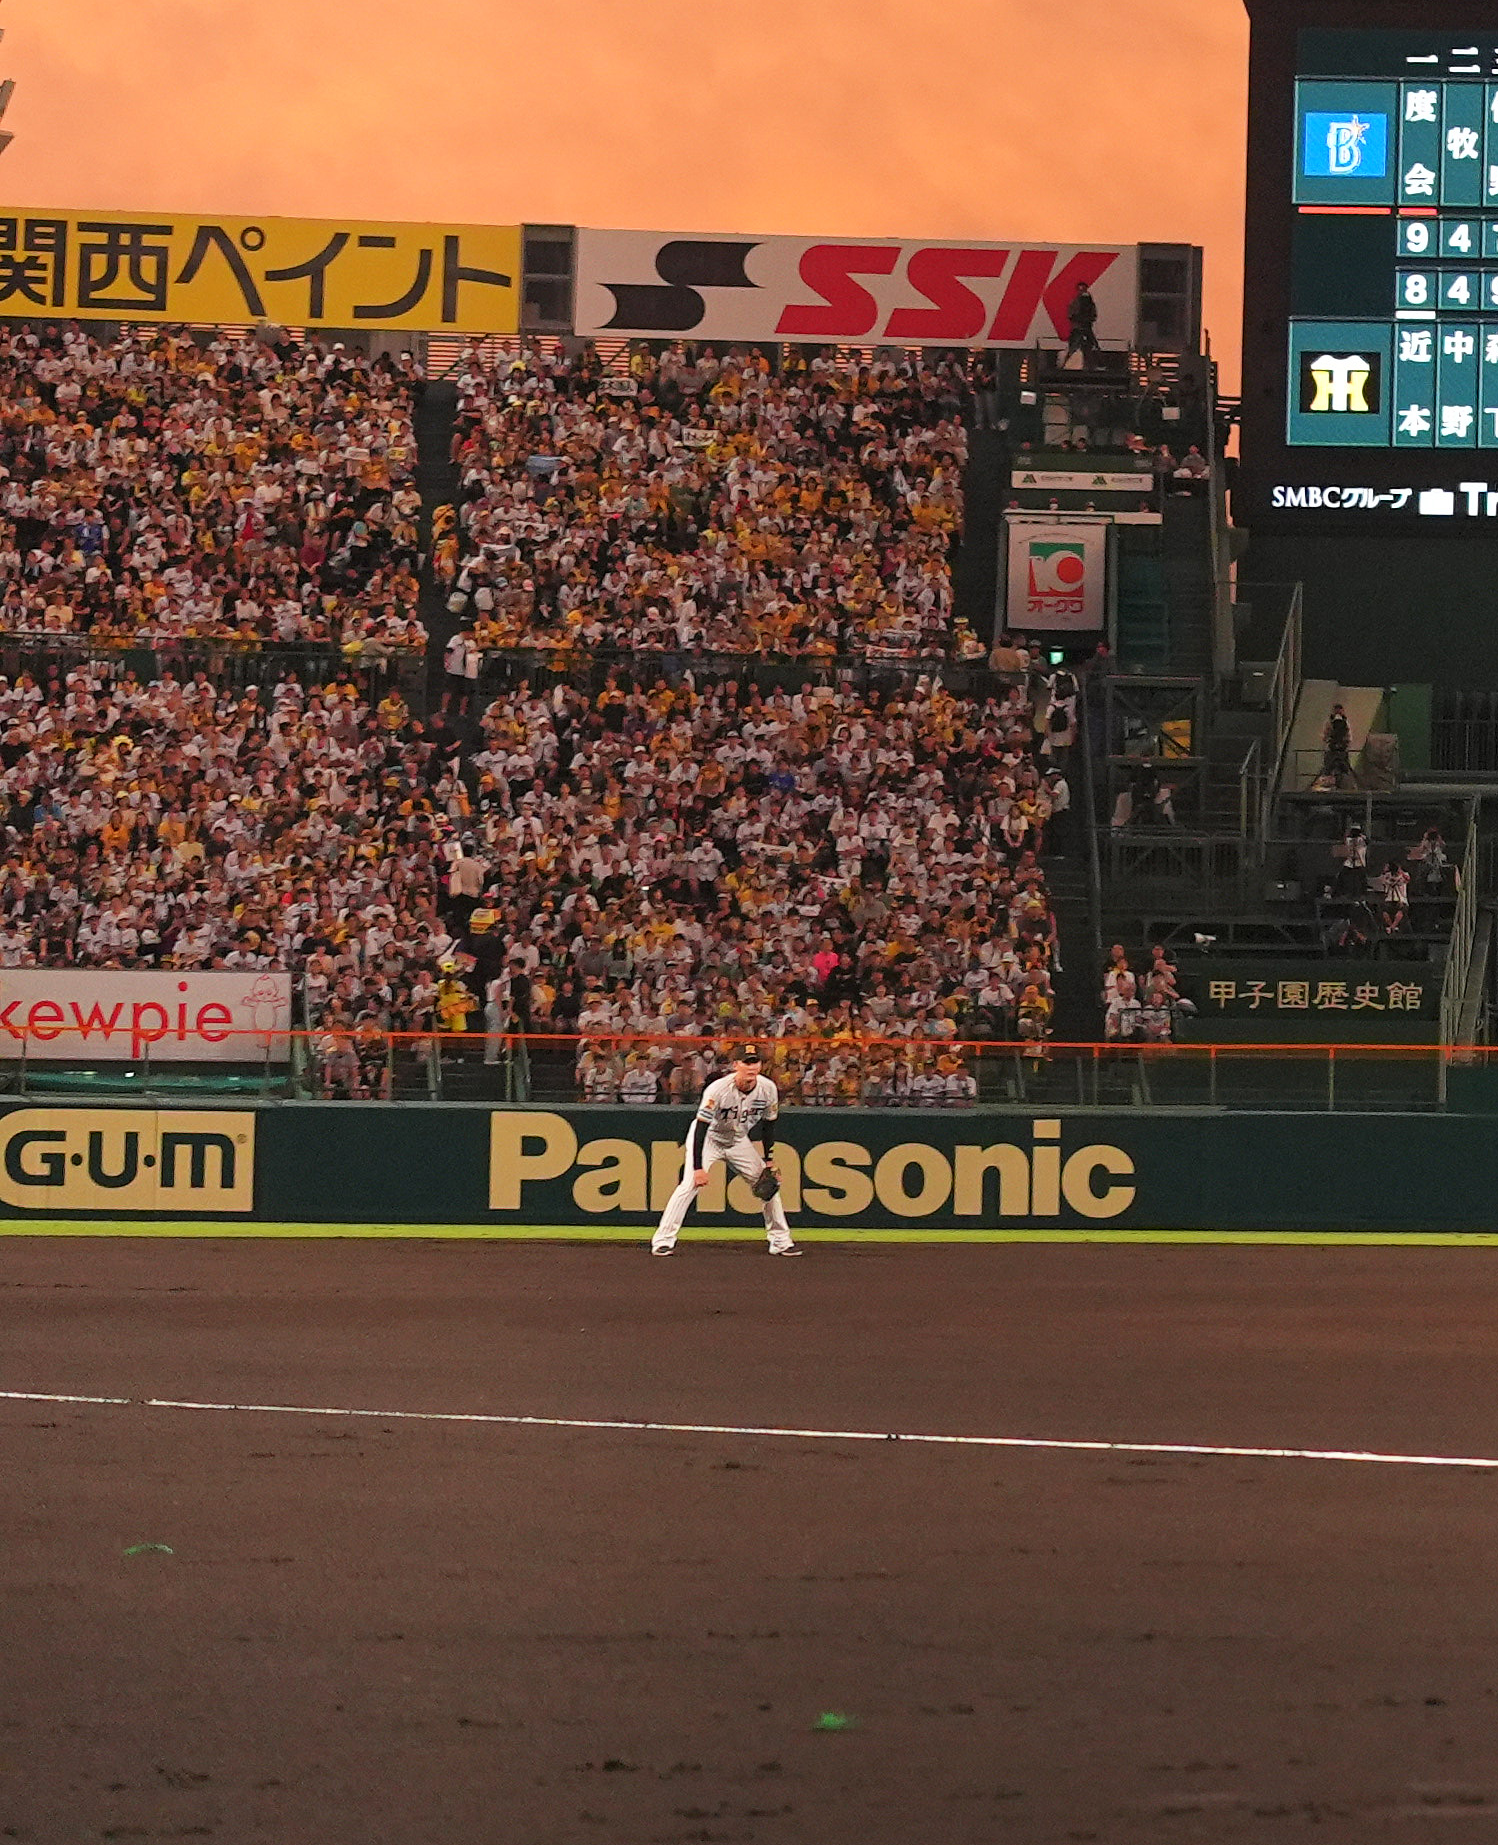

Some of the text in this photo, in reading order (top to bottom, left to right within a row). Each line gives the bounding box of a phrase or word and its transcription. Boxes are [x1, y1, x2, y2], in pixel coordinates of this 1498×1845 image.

[1406, 54, 1439, 63] 一
[1448, 46, 1481, 73] 二
[1405, 91, 1437, 196] 度会
[1446, 126, 1479, 160] 牧
[1406, 222, 1429, 253] 9
[1448, 223, 1472, 253] 4
[0, 217, 512, 323] 関西ペイント
[774, 244, 1121, 343] SSK
[1404, 273, 1428, 305] 8
[1447, 275, 1471, 305] 4
[1398, 330, 1432, 437] 近本
[1442, 330, 1474, 438] 中野
[1271, 485, 1413, 510] SMBCグループ
[1027, 599, 1085, 615] オークワ
[1208, 980, 1424, 1012] 甲子園歴史館
[488, 1110, 1136, 1219] Panasonic
